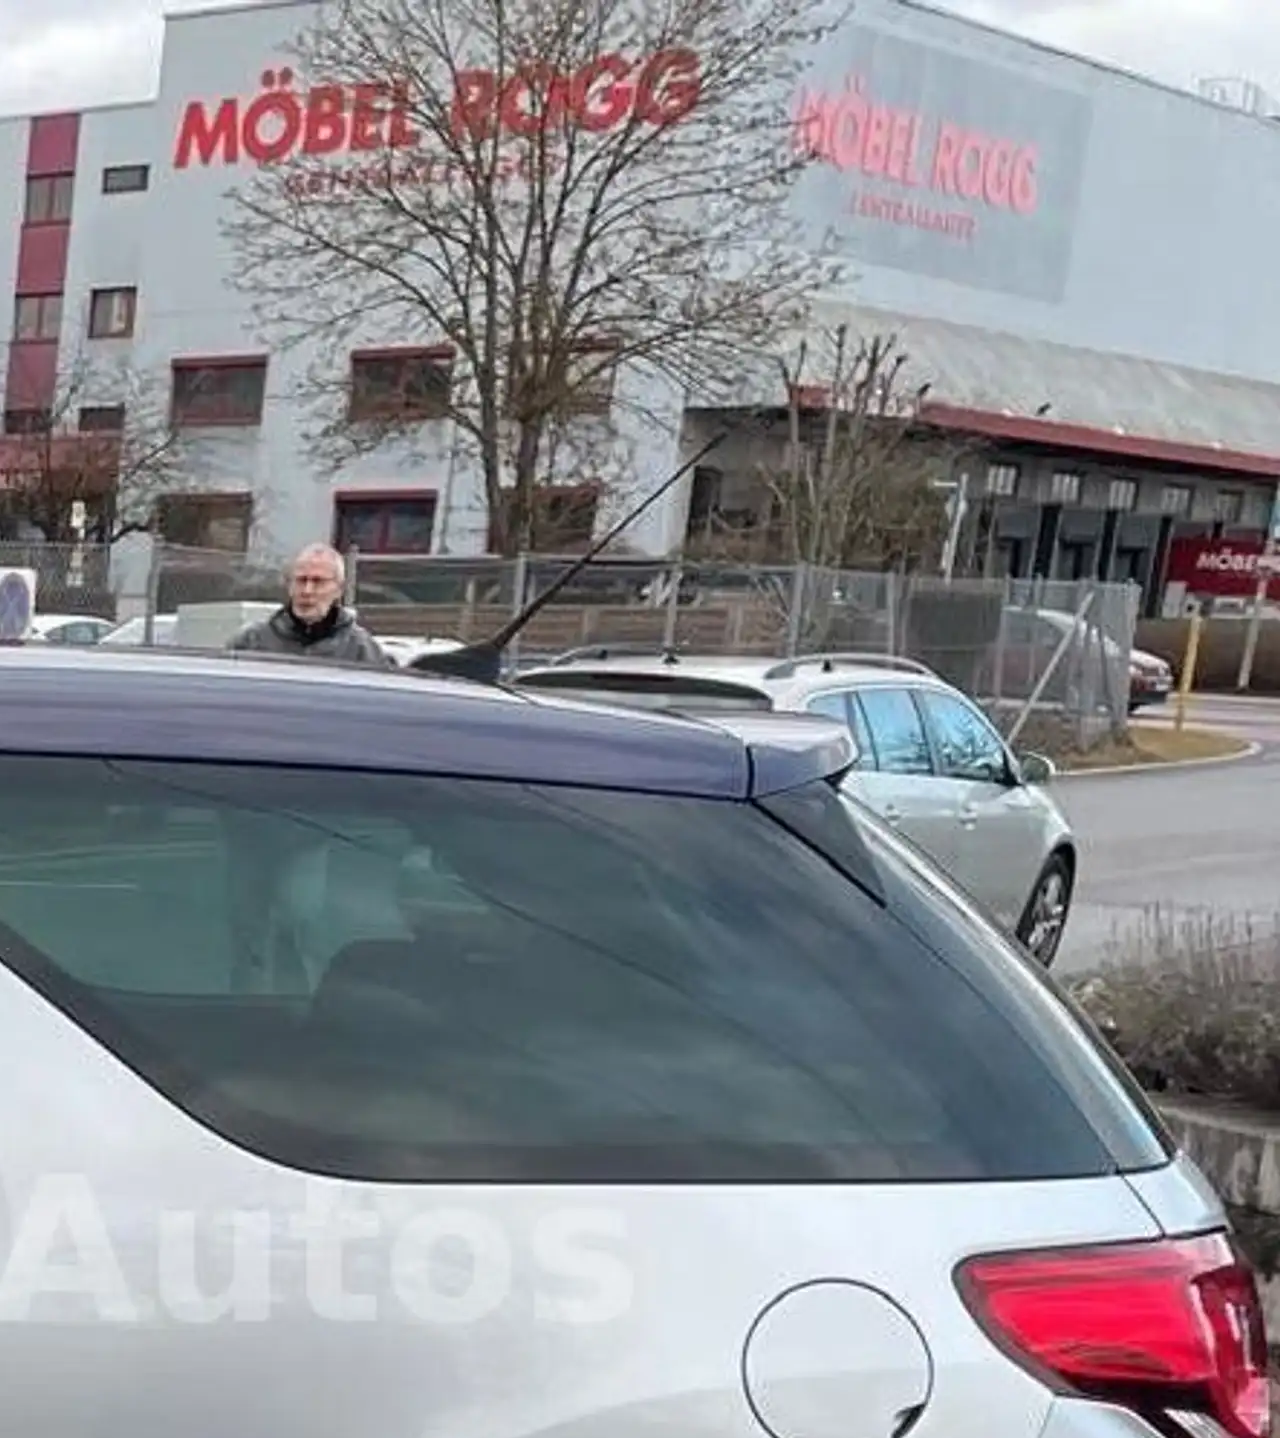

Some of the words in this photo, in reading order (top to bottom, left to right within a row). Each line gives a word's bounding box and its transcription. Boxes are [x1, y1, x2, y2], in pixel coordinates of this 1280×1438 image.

[174, 66, 416, 168] MÖBEL
[453, 47, 703, 141] ROGG
[796, 74, 921, 187] MÖBEL
[932, 119, 1039, 216] ROGG
